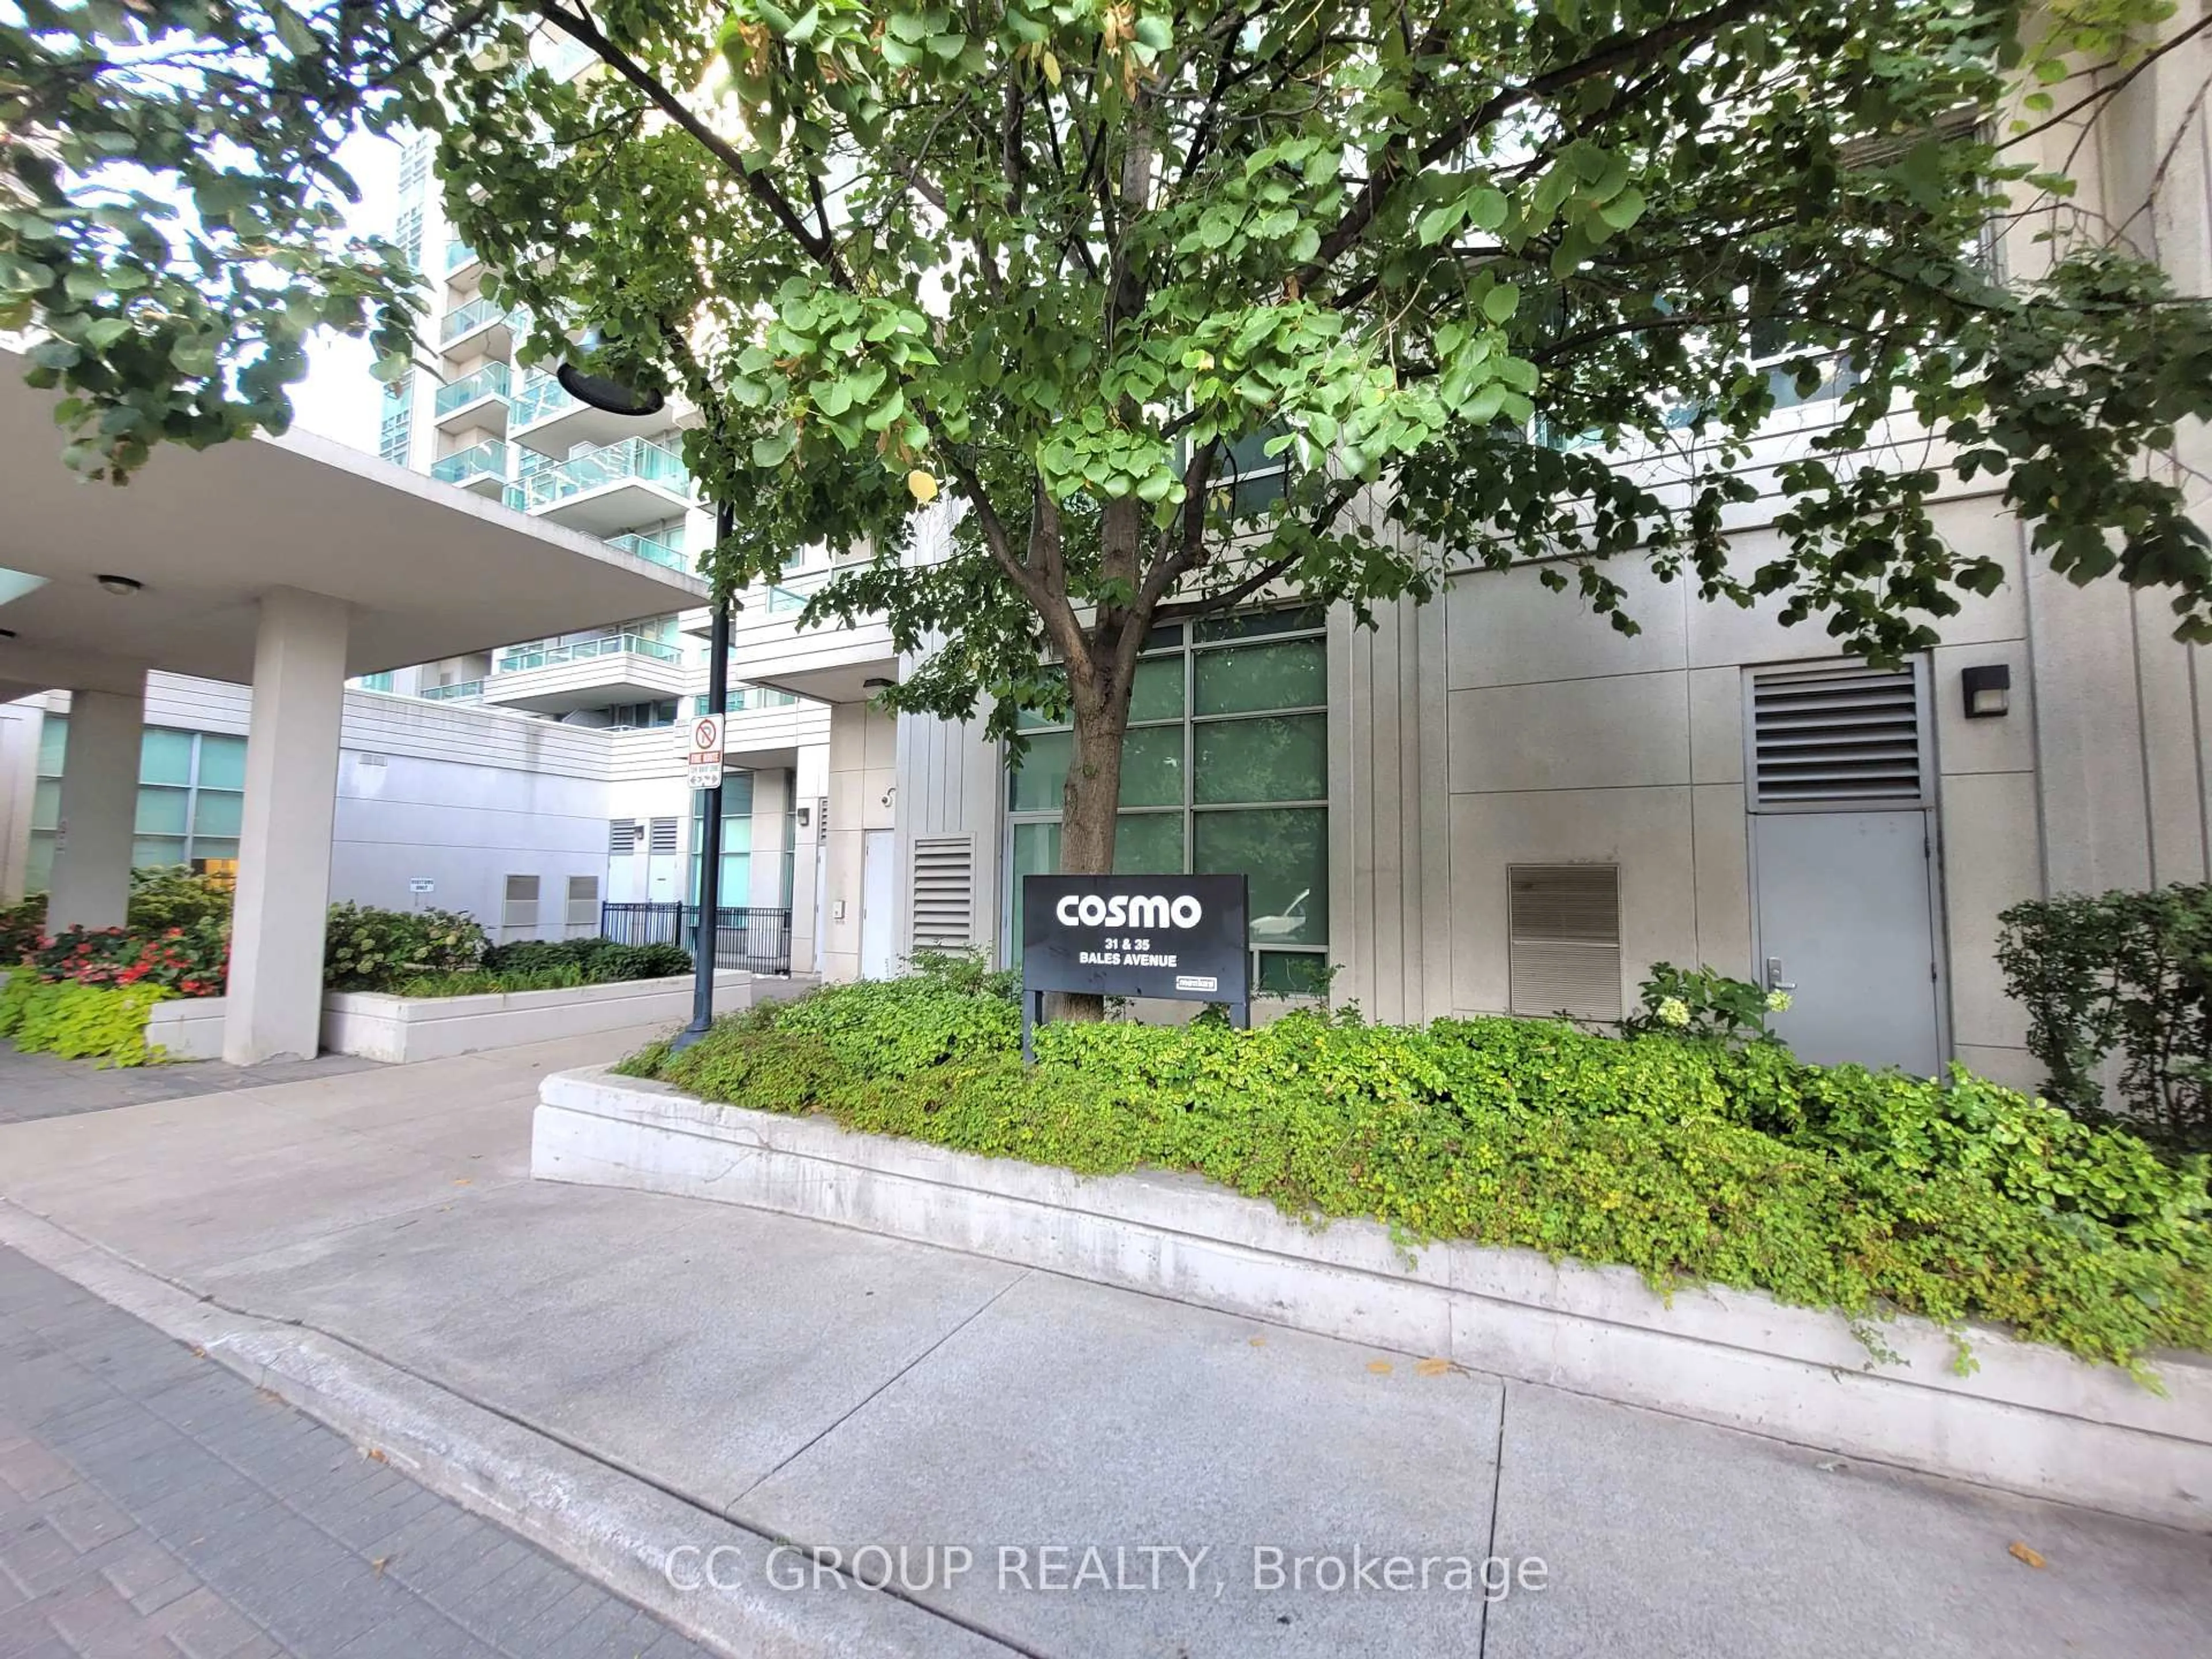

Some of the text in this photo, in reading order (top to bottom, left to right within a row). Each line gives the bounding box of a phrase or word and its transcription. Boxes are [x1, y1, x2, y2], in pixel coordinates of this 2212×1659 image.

[1056, 895, 1202, 929] COSMO
[1105, 938, 1150, 950] 31 & 35
[1079, 952, 1177, 967] BALES AVENUE
